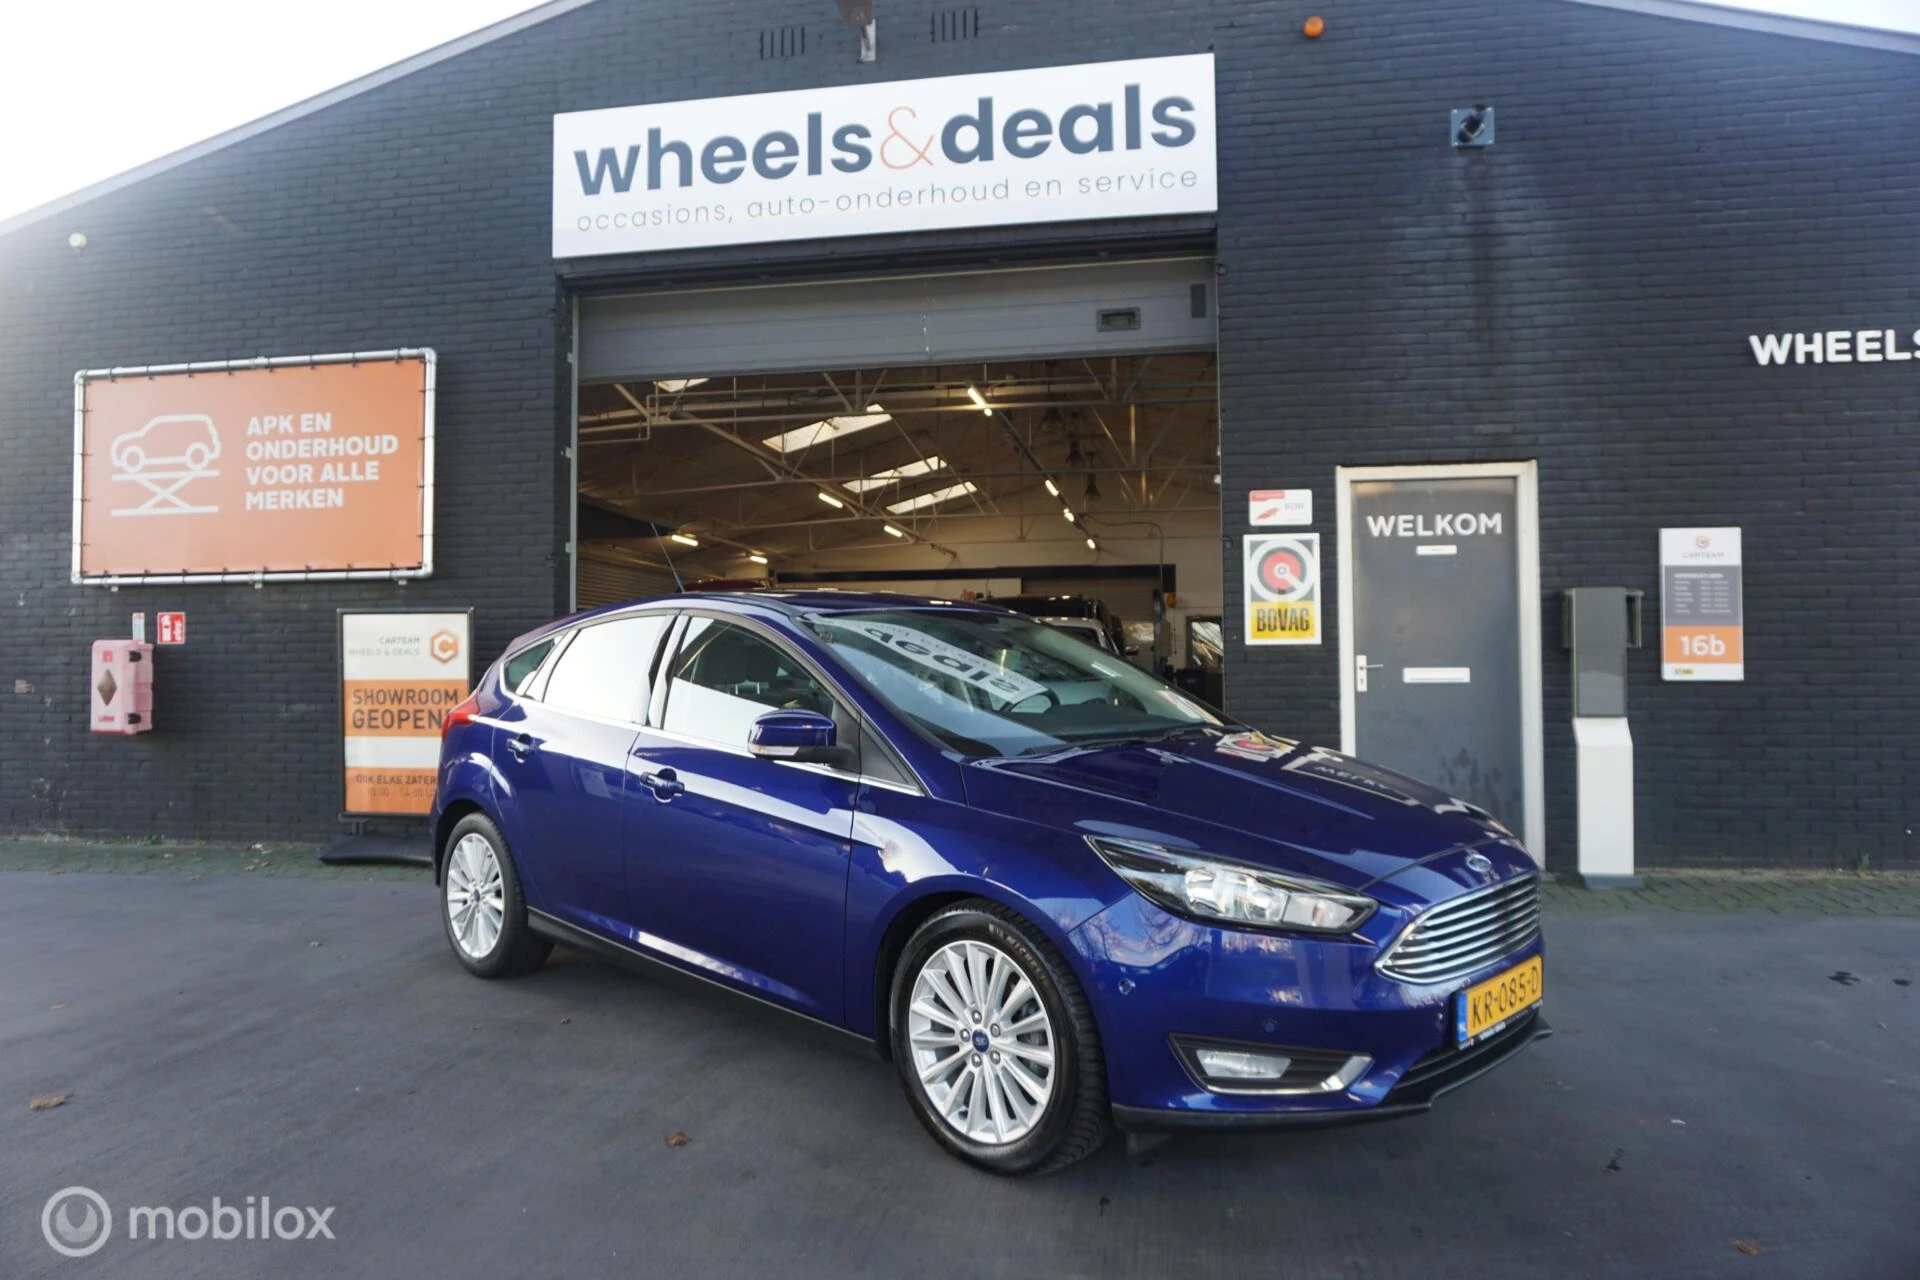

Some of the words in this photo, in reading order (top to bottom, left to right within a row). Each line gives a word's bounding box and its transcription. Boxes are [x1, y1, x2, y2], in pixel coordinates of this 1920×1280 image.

[577, 204, 733, 232] occasions,
[747, 179, 1009, 219] auto-onderhoud
[1025, 178, 1061, 198] en
[1078, 167, 1199, 195] service
[1748, 328, 1920, 366] WHEEL
[246, 415, 294, 436] APK
[300, 411, 332, 433] EN
[246, 434, 399, 461] ONDERHOUD
[246, 463, 314, 485] VOOR
[319, 460, 380, 482] ALLE
[245, 487, 344, 511] MERKEN
[1366, 512, 1503, 537] WELKOM
[1256, 607, 1310, 632] BOVAG
[379, 636, 420, 645] CARTEAM
[1680, 633, 1726, 657] 16b
[352, 688, 459, 706] SHOWROOM
[352, 708, 451, 729] GEOPEN
[377, 775, 402, 785] ELKE
[405, 775, 437, 785] ZATER
[1472, 965, 1540, 1030] KR-085-D
